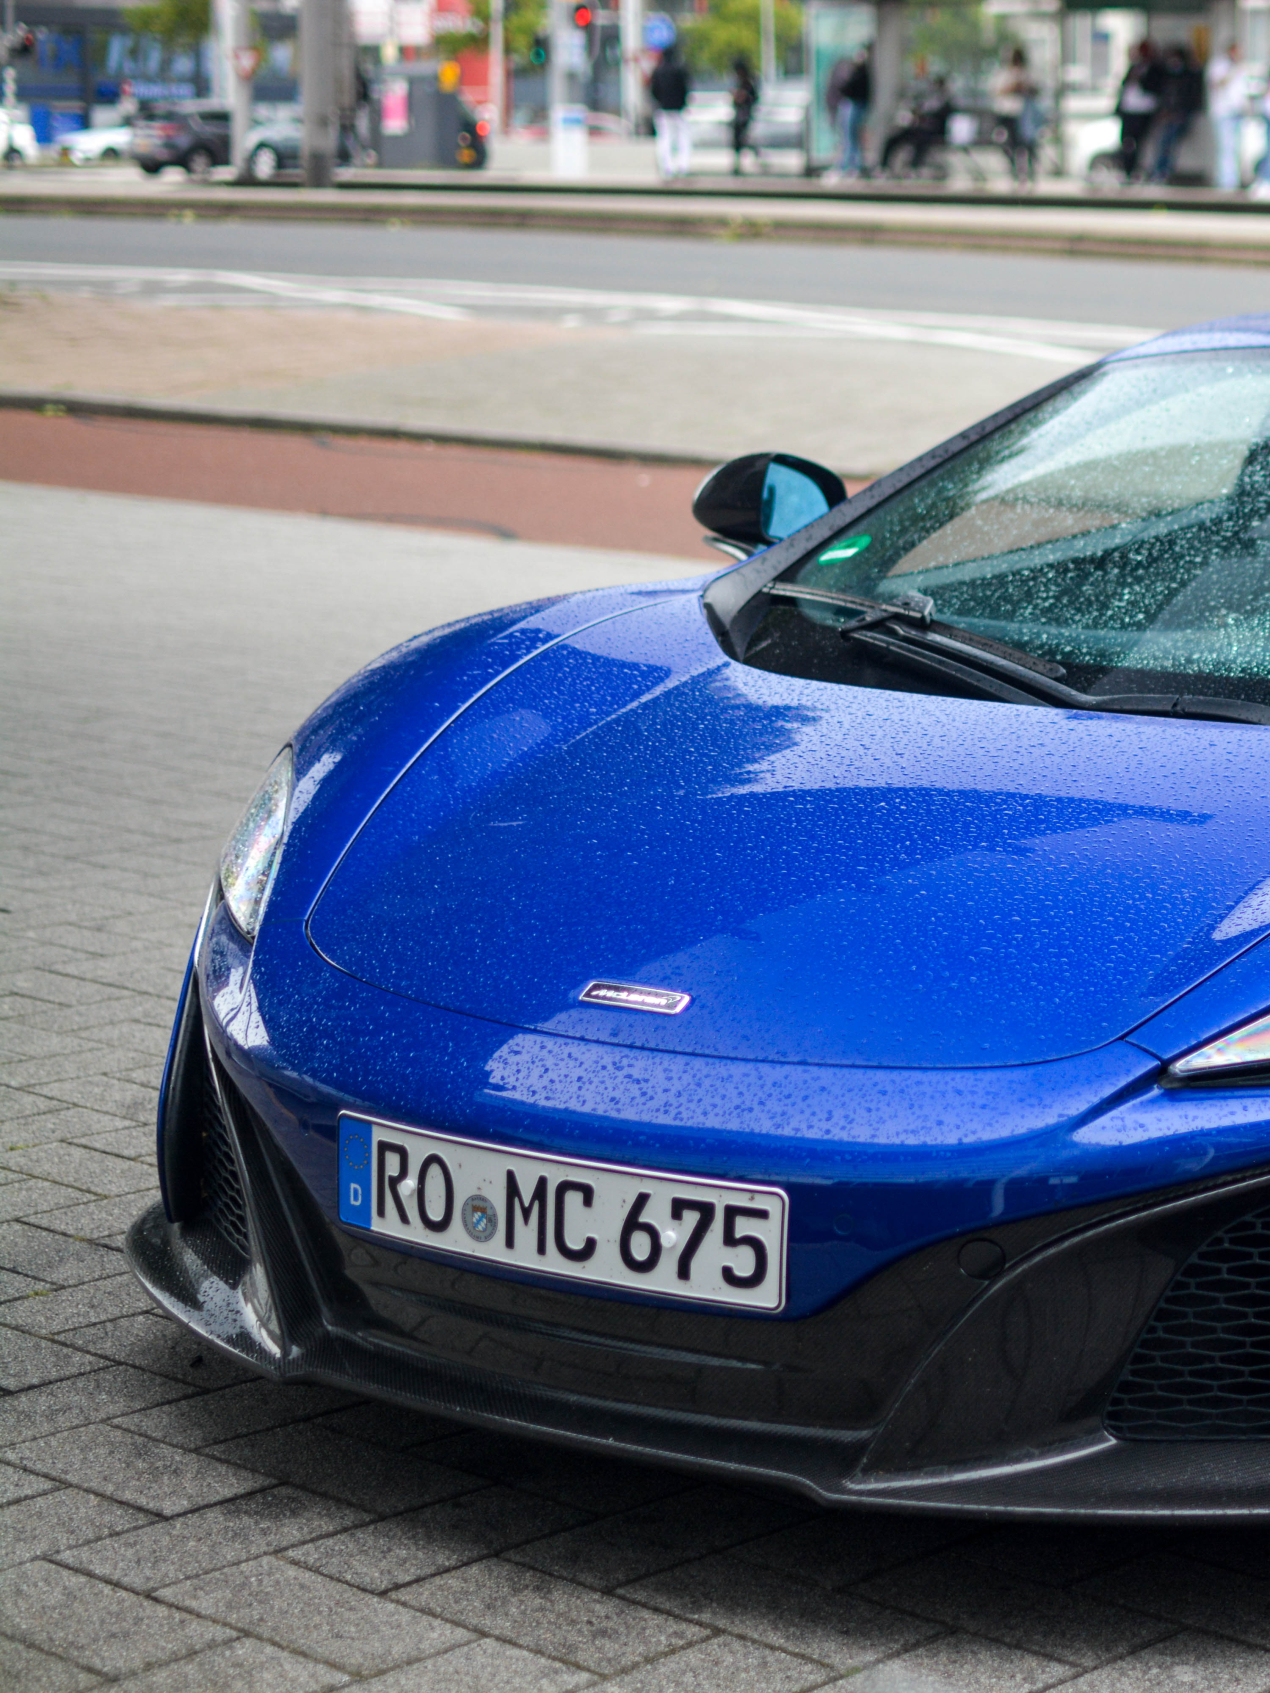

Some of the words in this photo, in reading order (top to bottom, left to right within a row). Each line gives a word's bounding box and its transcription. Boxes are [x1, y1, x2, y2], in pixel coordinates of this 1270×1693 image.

[350, 1183, 361, 1206] D
[376, 1138, 454, 1233] RO
[504, 1168, 598, 1262] MC
[619, 1191, 770, 1288] 675
